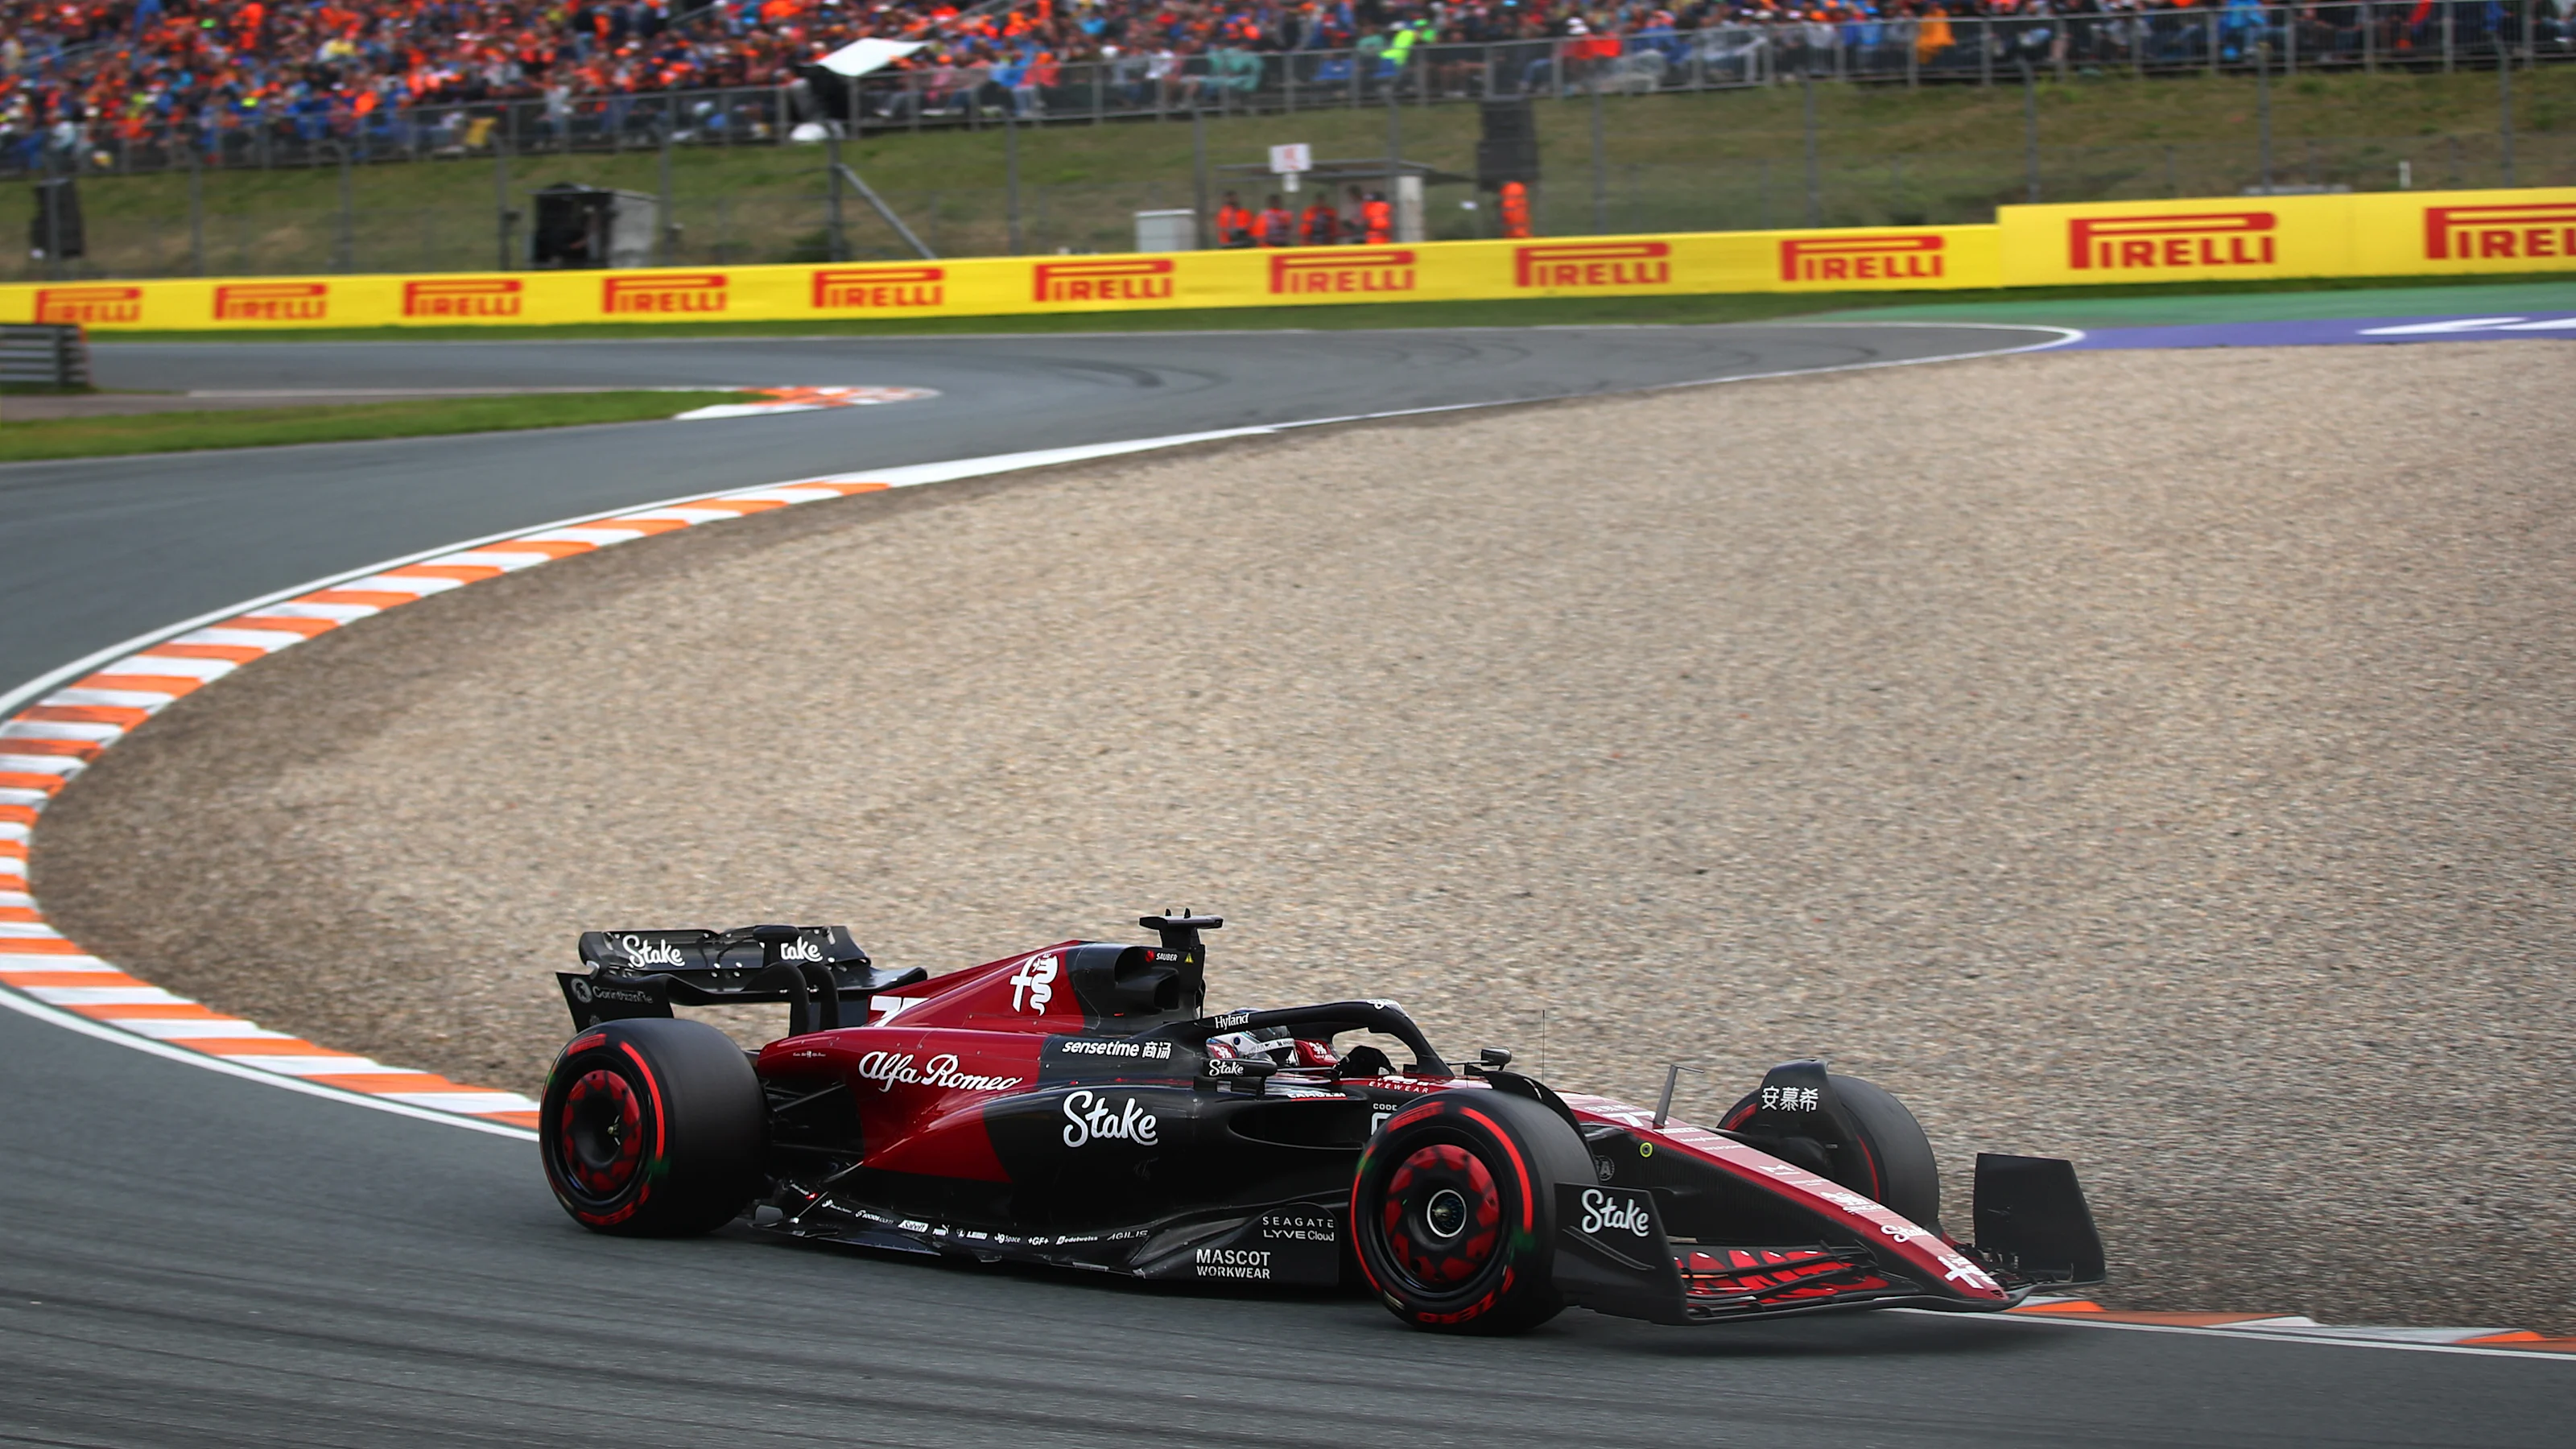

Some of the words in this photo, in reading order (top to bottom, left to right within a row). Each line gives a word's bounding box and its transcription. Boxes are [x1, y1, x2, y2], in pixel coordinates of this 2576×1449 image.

[2067, 211, 2277, 270] PIRELLI
[2422, 202, 2576, 260] PIREL
[1268, 250, 1418, 294] PIRELLI
[1514, 242, 1670, 288] PIRELLI
[1780, 234, 1945, 281] PIRELLI
[403, 279, 523, 316] PIRELLI
[601, 275, 728, 313] PIRELLI
[811, 267, 945, 308] PIRELLI
[1033, 258, 1174, 302] PIRELLI
[35, 287, 142, 323] PIRELLI
[213, 283, 328, 320] PIRELLI
[622, 935, 686, 968] Stake
[775, 936, 823, 962] take
[1156, 952, 1178, 961] SAUBER
[1215, 1012, 1249, 1030] Hyland
[1062, 1040, 1139, 1057] sensetime
[1141, 1041, 1172, 1059] 商汤
[1209, 1059, 1244, 1076] Stake
[858, 1051, 922, 1092] Alfa
[921, 1054, 1023, 1091] Romeo
[1368, 1080, 1429, 1093] EYEWEAR
[1761, 1085, 1818, 1113] 安慕希
[1063, 1090, 1158, 1148] Stake
[1262, 1216, 1335, 1228] SEAGATE
[1581, 1188, 1649, 1236] Stake
[1263, 1229, 1306, 1240] LYVE
[1307, 1230, 1335, 1241] Cloud
[1196, 1249, 1271, 1266] MASCOT
[1196, 1265, 1271, 1279] WORKWEAR
